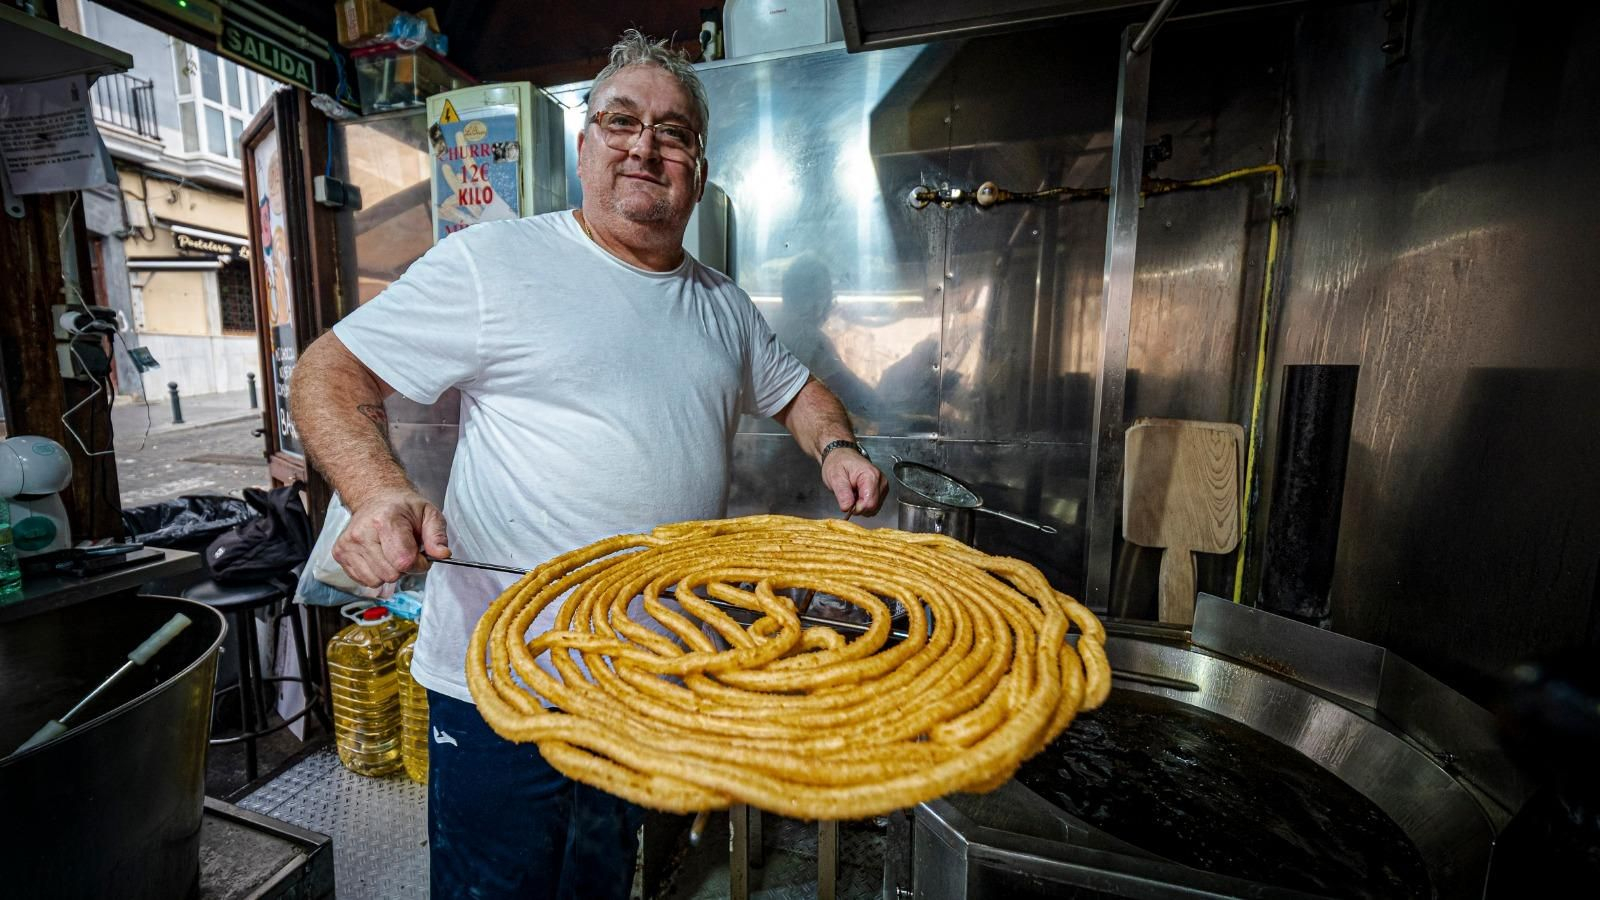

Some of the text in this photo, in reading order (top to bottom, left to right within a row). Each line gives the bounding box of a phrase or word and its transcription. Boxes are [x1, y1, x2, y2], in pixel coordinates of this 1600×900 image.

[225, 27, 310, 84] SALIDA
[437, 143, 492, 161] HURR
[461, 163, 490, 183] 12€
[458, 186, 493, 206] KILO
